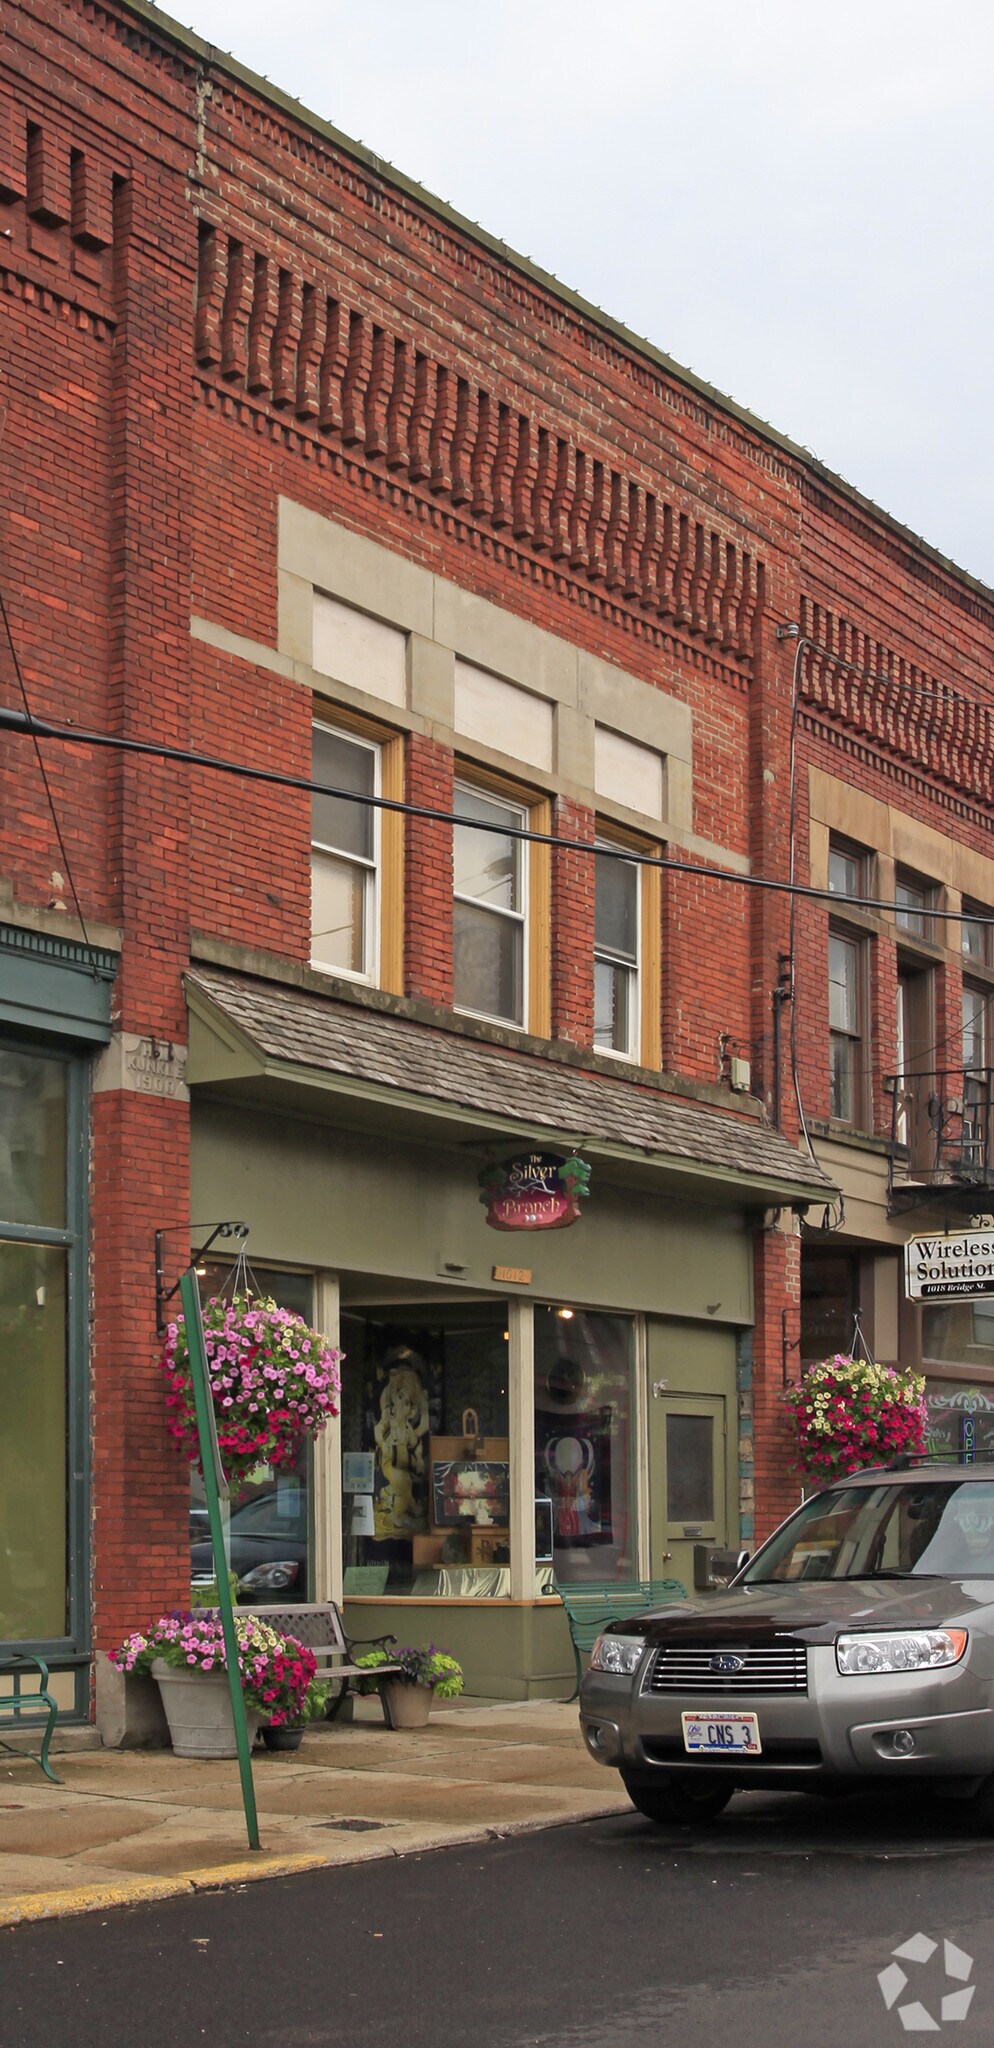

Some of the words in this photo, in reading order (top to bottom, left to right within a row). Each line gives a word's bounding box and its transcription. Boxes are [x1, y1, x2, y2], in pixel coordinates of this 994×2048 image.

[128, 1055, 184, 1080] KUNKLE
[529, 1154, 543, 1163] The
[509, 1162, 556, 1182] Silver
[503, 1197, 560, 1216] Branch
[916, 1239, 994, 1260] Wireles
[501, 1269, 525, 1281] 1012
[927, 1285, 946, 1293] 1018
[947, 1283, 974, 1292] Bridge
[707, 1724, 734, 1745] CNS
[741, 1725, 752, 1745] 3
